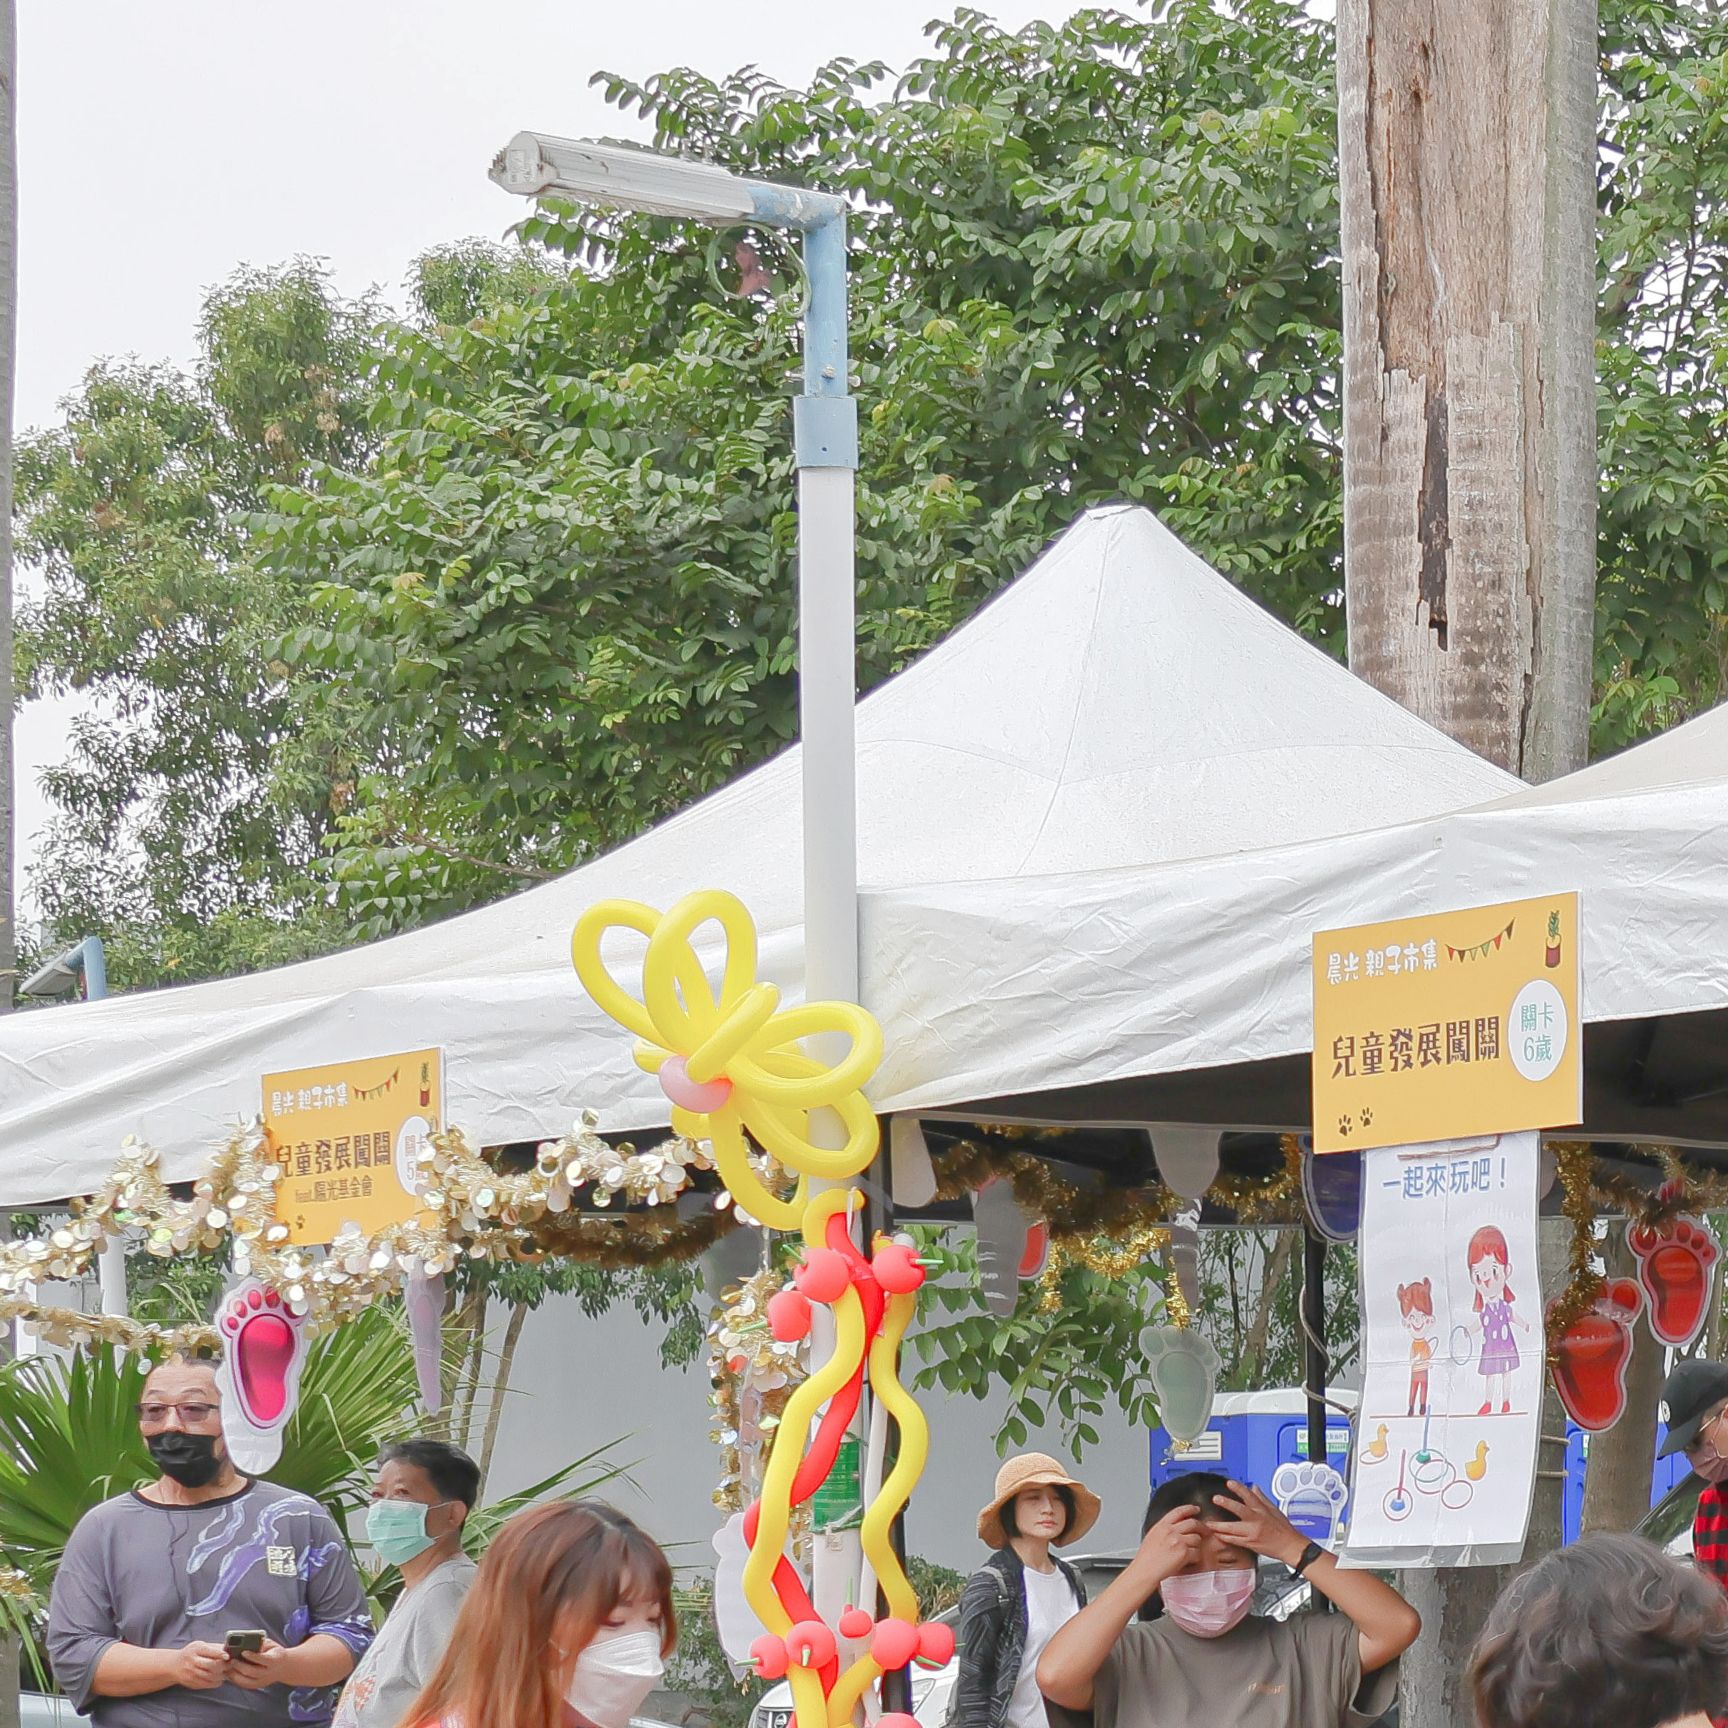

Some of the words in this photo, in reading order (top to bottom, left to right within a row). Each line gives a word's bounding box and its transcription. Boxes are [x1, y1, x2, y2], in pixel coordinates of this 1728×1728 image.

[1366, 939, 1438, 977] 親子市集
[1520, 1001, 1554, 1032] 關卡
[1331, 1016, 1500, 1079] 兒童發展闖關
[1523, 1035, 1552, 1062] 6歲
